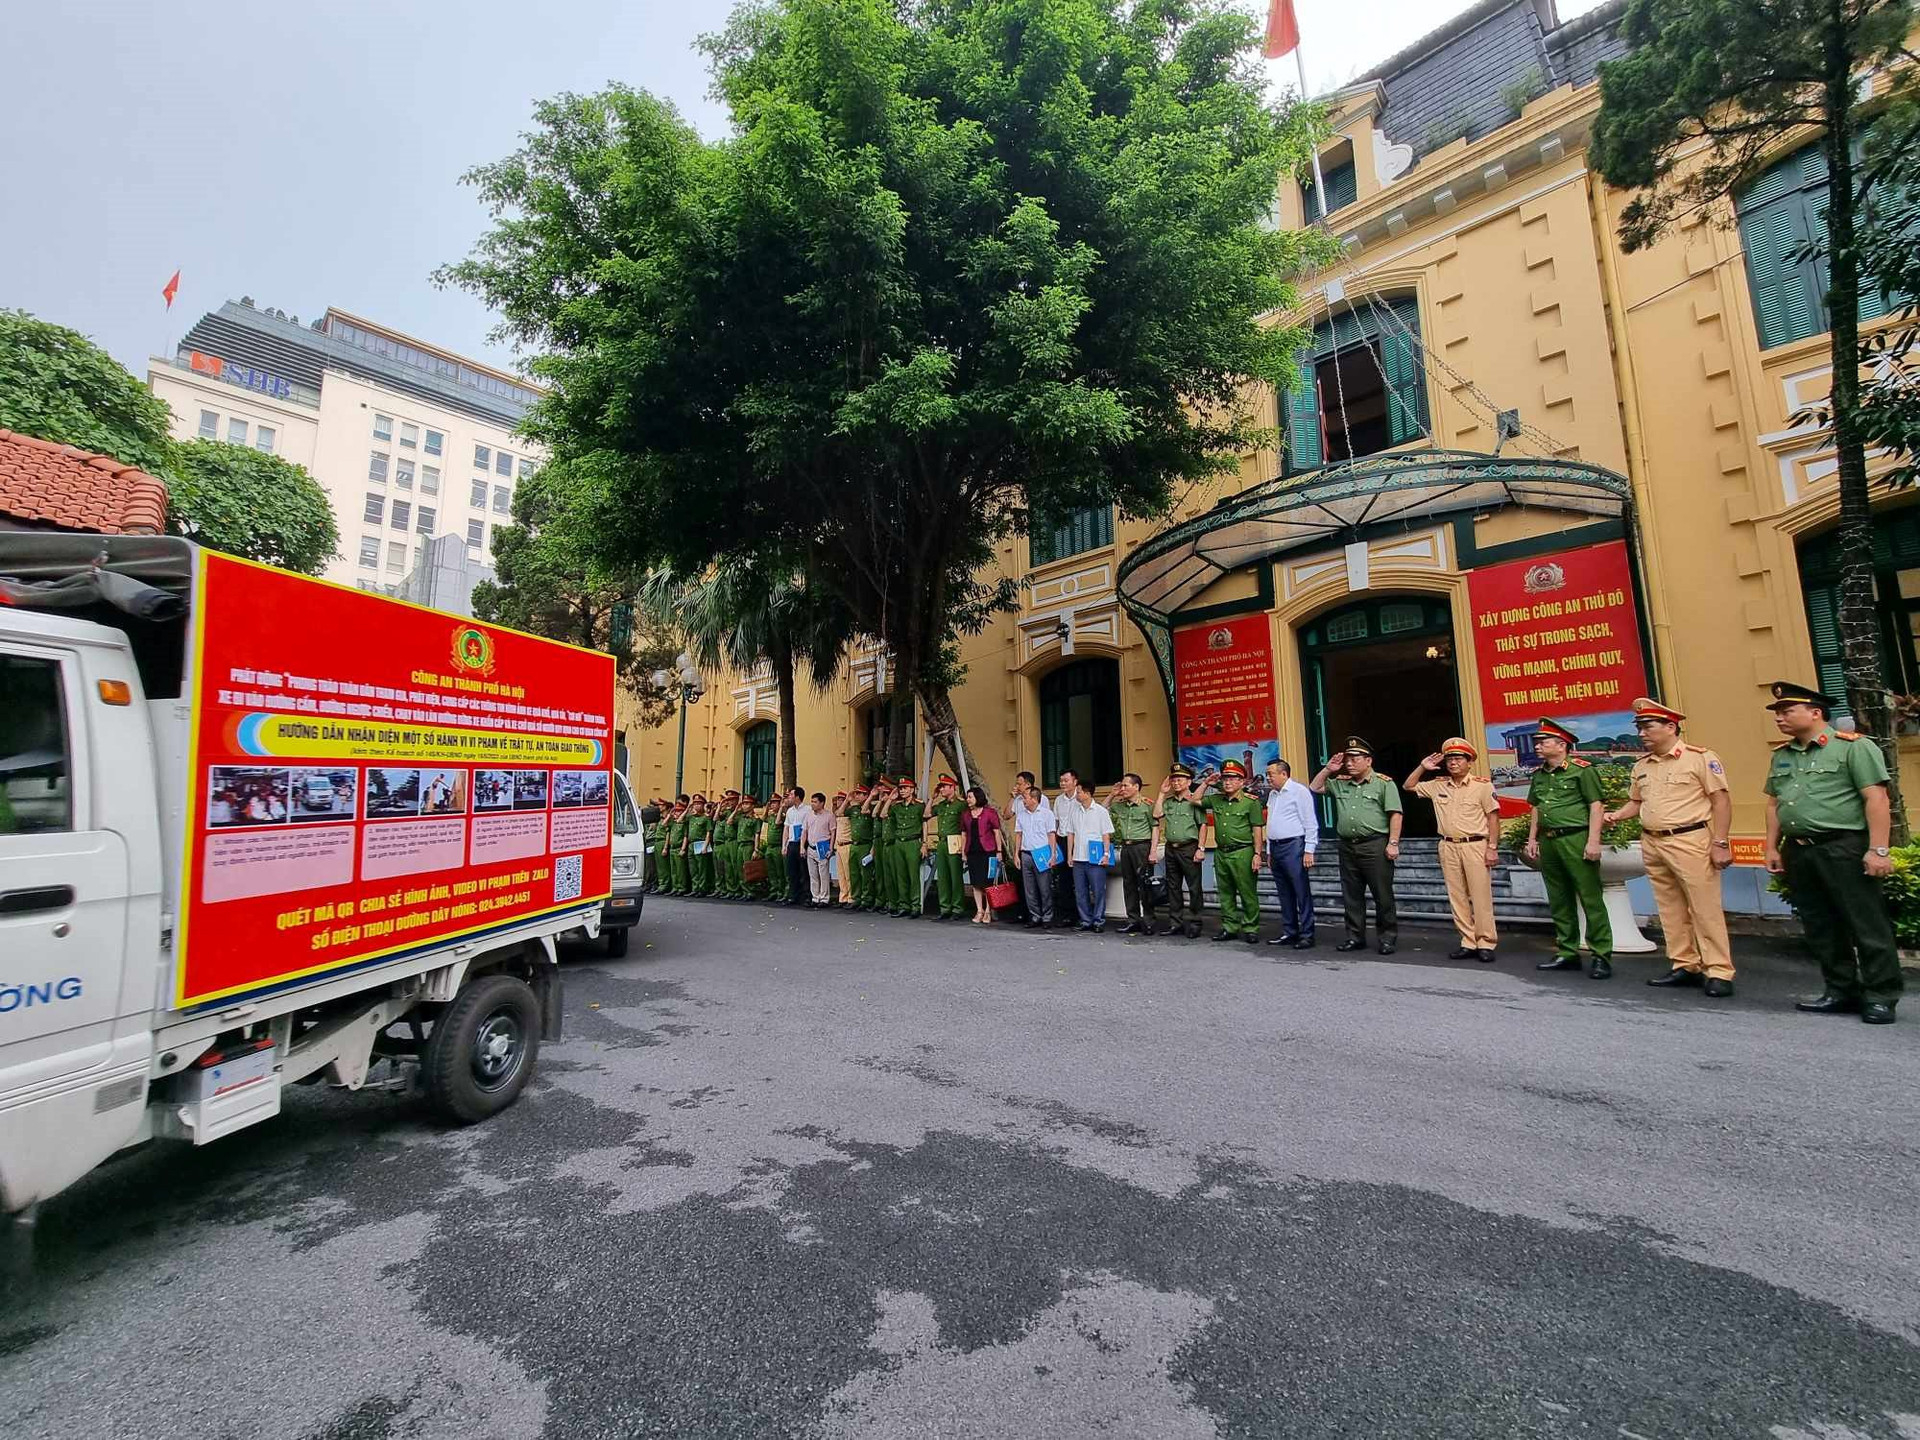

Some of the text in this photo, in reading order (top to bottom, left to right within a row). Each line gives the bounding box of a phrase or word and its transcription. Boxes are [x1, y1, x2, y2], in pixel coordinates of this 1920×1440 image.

[225, 361, 293, 399] SHB
[1479, 589, 1624, 628] XÂY DỰNG CÔNG AN THỦ ĐÔ
[1495, 622, 1614, 653] THẬT SỰ TRONG SẠCH,
[1492, 650, 1625, 680] VỮNG MẠNH, CHÍNH QUY,
[411, 669, 525, 700] CÔNG AN THÀNH PHỐ HÀ NỘI
[1503, 679, 1620, 706] TINH NHUỆ, HIỆN ĐẠI!
[277, 722, 319, 739] HƯỚNG
[322, 722, 345, 740] DẪN
[347, 727, 375, 744] NHẬN
[379, 728, 400, 746] DIỆN
[402, 730, 421, 747] MỘT
[423, 730, 434, 746] SỐ
[436, 733, 458, 747] HÀNH
[460, 736, 467, 747] VI
[469, 737, 476, 748] VI
[478, 737, 498, 751] PHẠM
[509, 738, 524, 752] TRẬT
[536, 741, 545, 751] AN
[545, 741, 560, 752] TOÀN
[560, 743, 573, 753] GIAO
[277, 907, 312, 930] QUÉT
[314, 902, 335, 922] MÃ
[337, 902, 354, 918] QR
[360, 896, 386, 913] CHIA
[388, 889, 402, 908] SẺ
[404, 889, 428, 905] HÌNH
[453, 881, 477, 896] VIDEO
[479, 879, 487, 891] VI
[488, 875, 511, 890] PHẠM
[512, 870, 530, 884] TRÊN
[532, 868, 549, 881] ZALO
[311, 927, 330, 950] SỐ
[331, 925, 361, 945] ĐIỆN
[363, 919, 394, 938] THOẠI
[396, 911, 430, 931] ĐƯỜNG
[431, 906, 449, 923] DÂY
